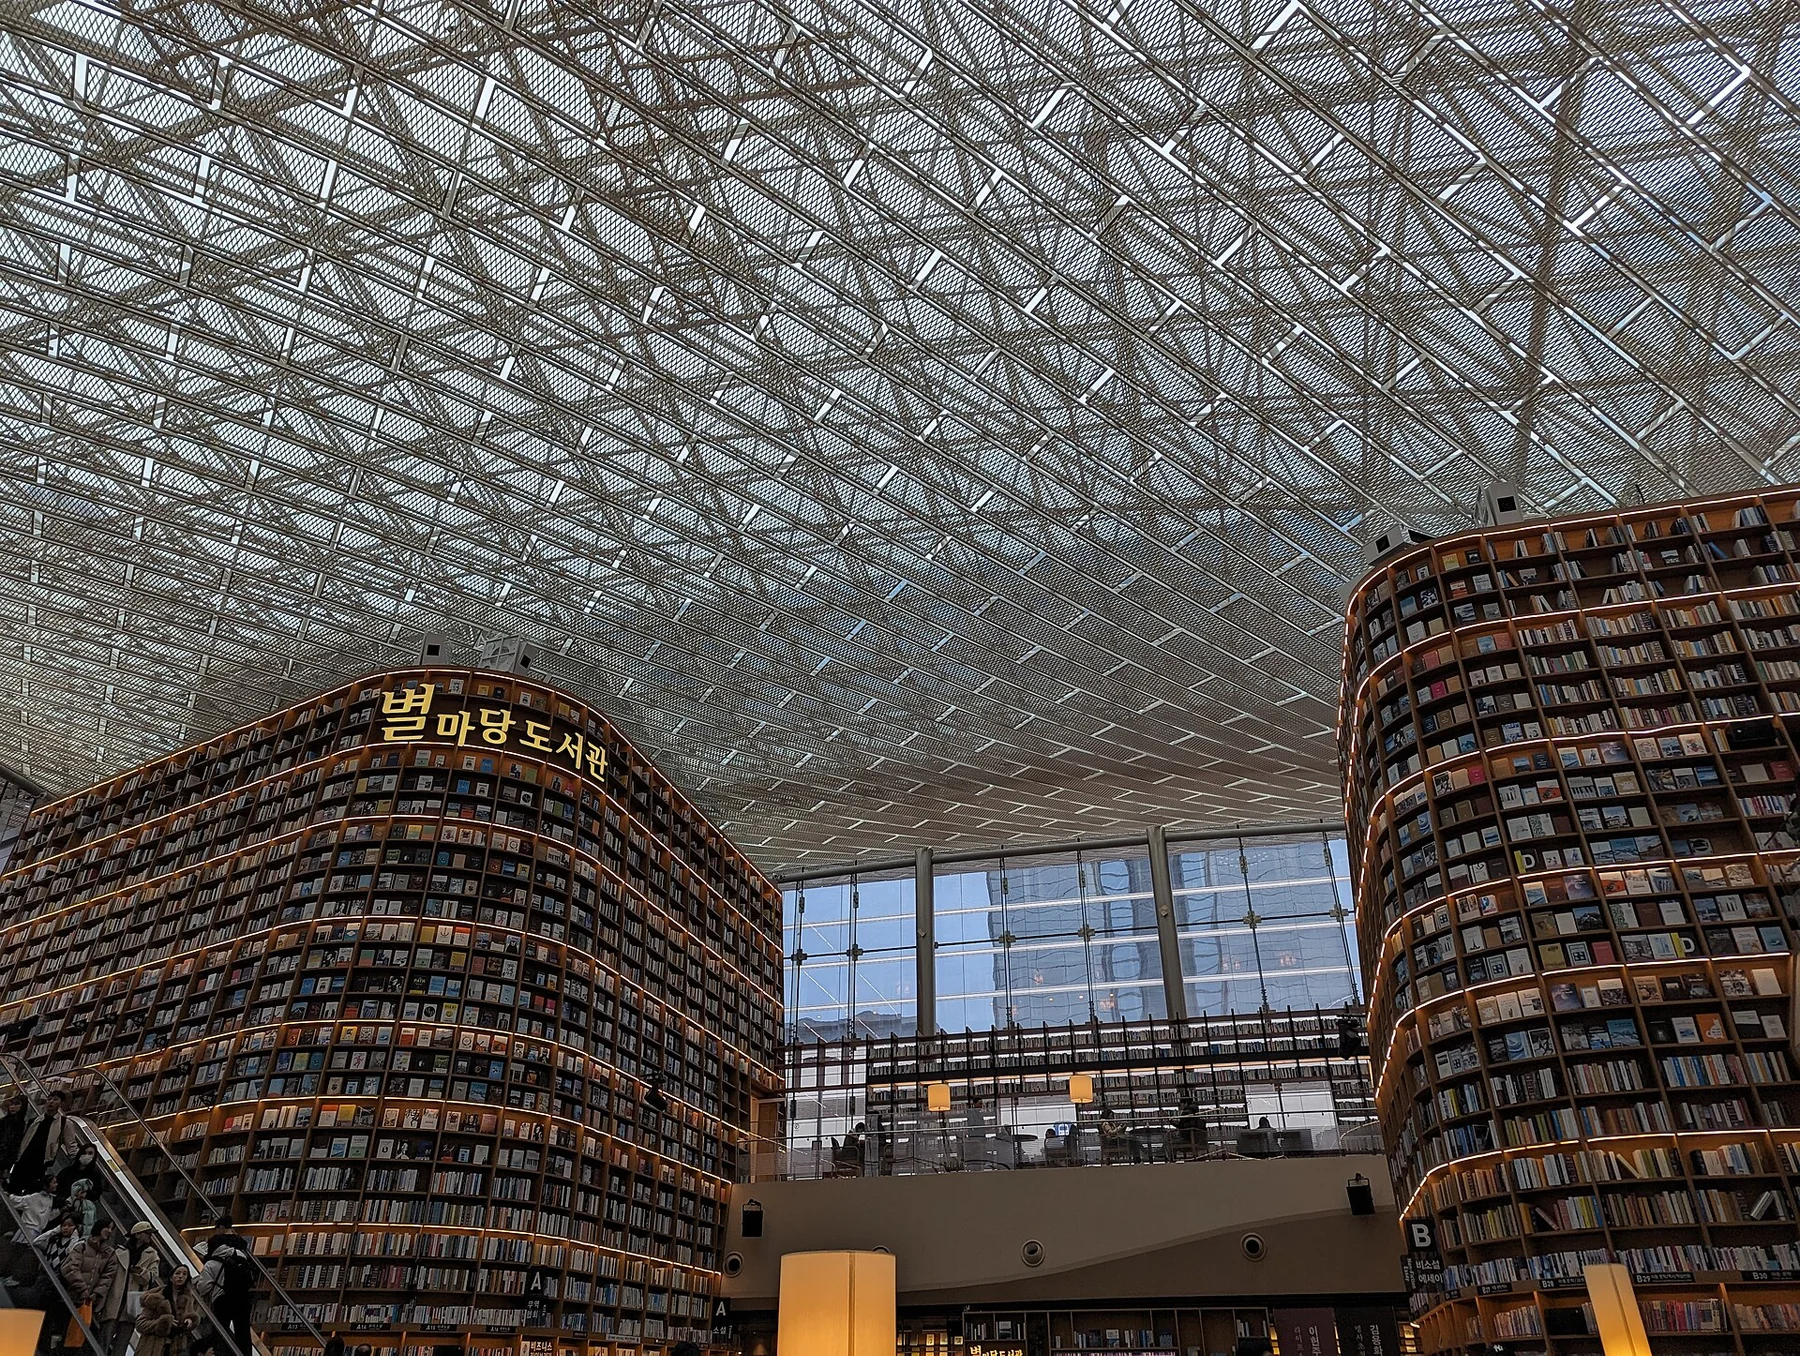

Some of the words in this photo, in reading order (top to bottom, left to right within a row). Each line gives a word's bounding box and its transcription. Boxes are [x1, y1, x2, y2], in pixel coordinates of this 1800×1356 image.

[1411, 1223, 1432, 1248] B
[1415, 1260, 1441, 1270] 비소설
[530, 1271, 542, 1291] A
[1418, 1273, 1443, 1284] 에세이
[1636, 1274, 1651, 1283] B29
[1752, 1272, 1768, 1280] B30
[715, 1301, 727, 1316] A
[712, 1326, 727, 1335] 소설
